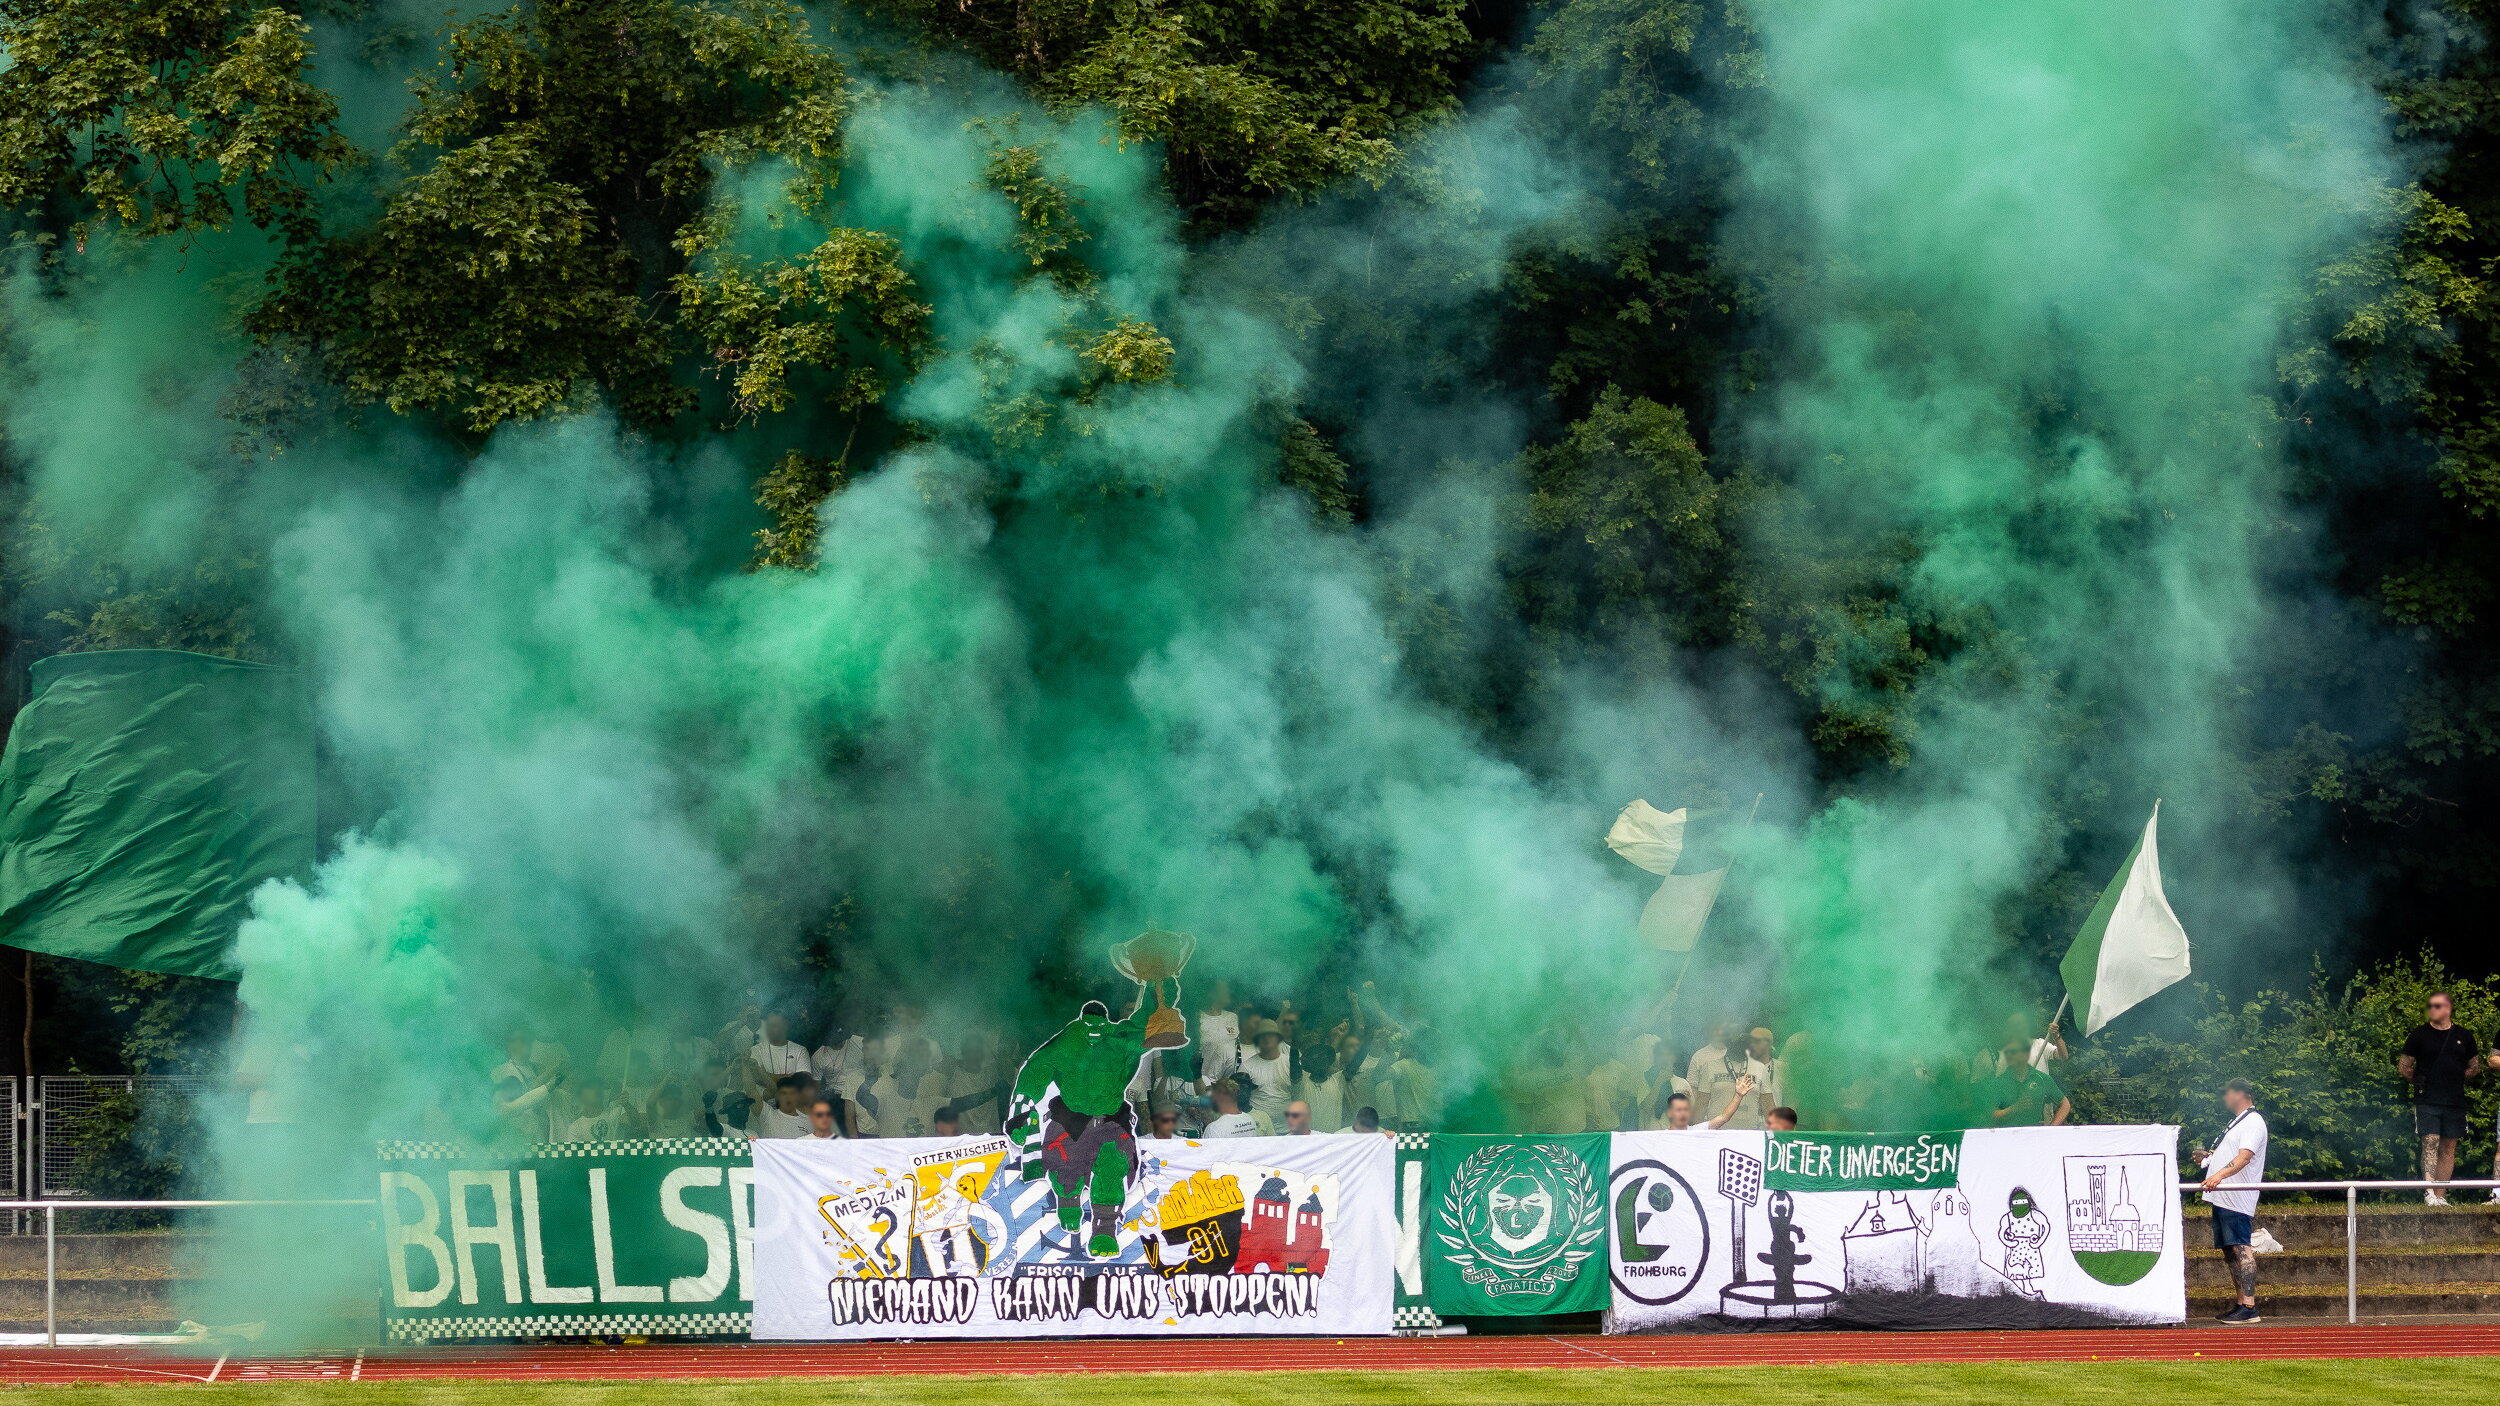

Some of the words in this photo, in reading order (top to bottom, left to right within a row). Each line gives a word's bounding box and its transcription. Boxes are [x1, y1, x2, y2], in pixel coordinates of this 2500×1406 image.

[913, 1140, 1008, 1167] OTTERWISCHER
[1767, 1139, 1832, 1177] DIETER
[1839, 1134, 1958, 1183] UNVERGESSEN
[834, 1185, 907, 1219] MEDIZIN
[1186, 1220, 1230, 1264] 91
[1494, 1280, 1547, 1294] FANATICS
[1623, 1264, 1687, 1279] FROHBURG
[829, 1276, 979, 1326] NIEMAND
[991, 1275, 1083, 1323] KANN
[1095, 1273, 1160, 1320] UNS
[1174, 1273, 1322, 1319] STOPPEN!
